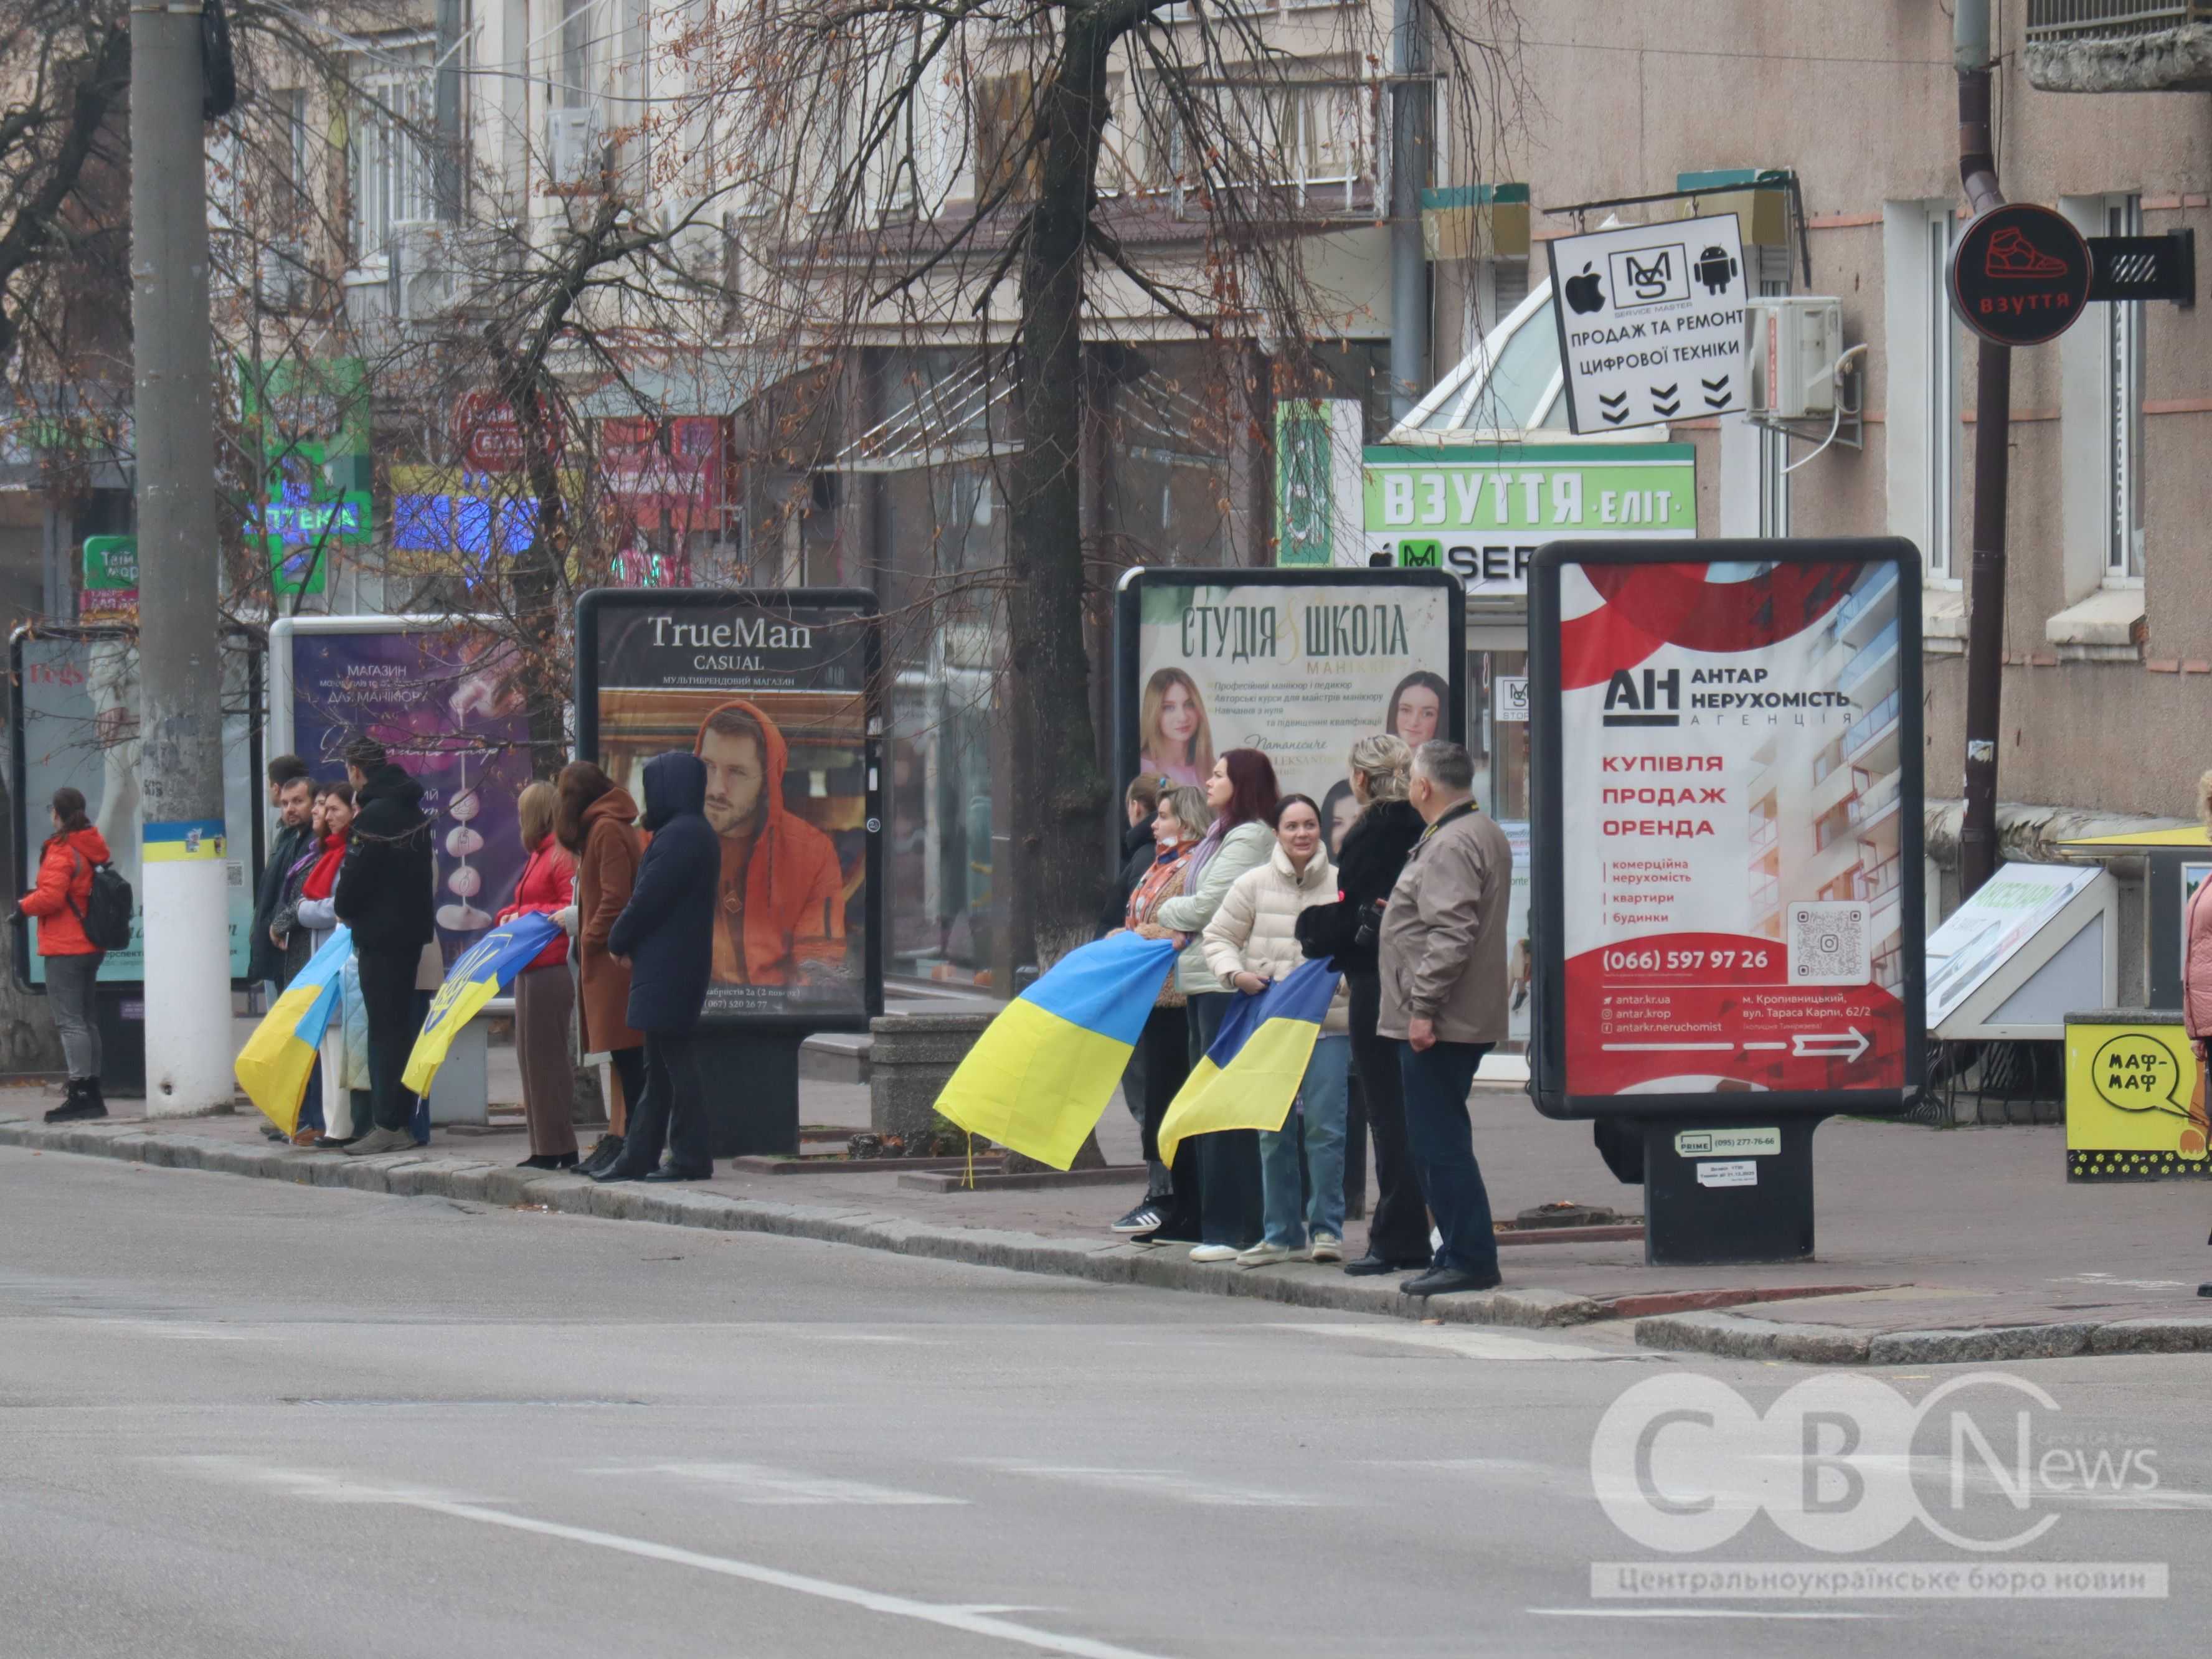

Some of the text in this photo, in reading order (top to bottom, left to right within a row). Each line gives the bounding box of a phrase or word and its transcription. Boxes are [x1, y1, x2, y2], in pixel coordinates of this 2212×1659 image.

[1614, 301, 1693, 319] SERVICE MASTER
[1979, 293, 2069, 316] ВЗУТТЯ
[1571, 310, 1744, 347] ПРОДАЖ ТА РЕМОНТ
[1580, 340, 1740, 376] ЦИФРОВОЇ ТЕХНІКИ
[1384, 473, 1584, 526] ВЗУТТЯ
[648, 617, 812, 648] TrueMan
[1182, 606, 1276, 664] СТУДІЯ
[1306, 604, 1409, 656] ШКОЛА
[694, 655, 765, 671] CASUAL
[347, 665, 407, 677] МАГАЗИН
[1691, 668, 1768, 684] АНТАР
[663, 675, 795, 686] МУЛЬТИБРЕНДОВИЙ МАГАЗИН
[1214, 681, 1270, 691] Професійний
[1271, 681, 1308, 691] манікюр
[1315, 682, 1353, 691] педикюр
[1604, 669, 1680, 710] АН
[1214, 694, 1256, 704] Авторські
[1258, 696, 1282, 704] курси
[1303, 694, 1340, 702] майстрів
[1342, 693, 1384, 702] манікюру
[1691, 692, 1850, 709] НЕРУХОМІСТЬ
[1214, 707, 1255, 715] Навчання
[1264, 707, 1283, 716] нуля
[1277, 719, 1328, 728] підвищення
[1329, 717, 1382, 727] кваліфікації
[1691, 714, 1851, 727] АГЕНЦІЯ
[1603, 755, 1724, 772] КУПІВЛЯ
[1603, 788, 1726, 806] ПРОДАЖ
[1603, 820, 1715, 838] ОРЕНДА
[1613, 858, 1689, 871] комерційна
[1613, 872, 1692, 884] нерухомість
[1613, 895, 1675, 904] квартири
[1613, 913, 1669, 925] будинки
[1604, 950, 1769, 971] (066) 597 97 26
[757, 988, 767, 996] (2
[1616, 996, 1671, 1004] antar.kr.ua
[1756, 993, 1847, 1005] Кропивницький,
[1616, 1010, 1671, 1019] antar.krop
[1743, 1006, 1871, 1019] вул. Тараса Карпи, 62/2
[1616, 1023, 1722, 1032] antarkr.neruchomist
[2109, 1074, 2157, 1092] МАФ
[1714, 1139, 1734, 1147] (095)
[1736, 1138, 1775, 1146] 277-76-66
